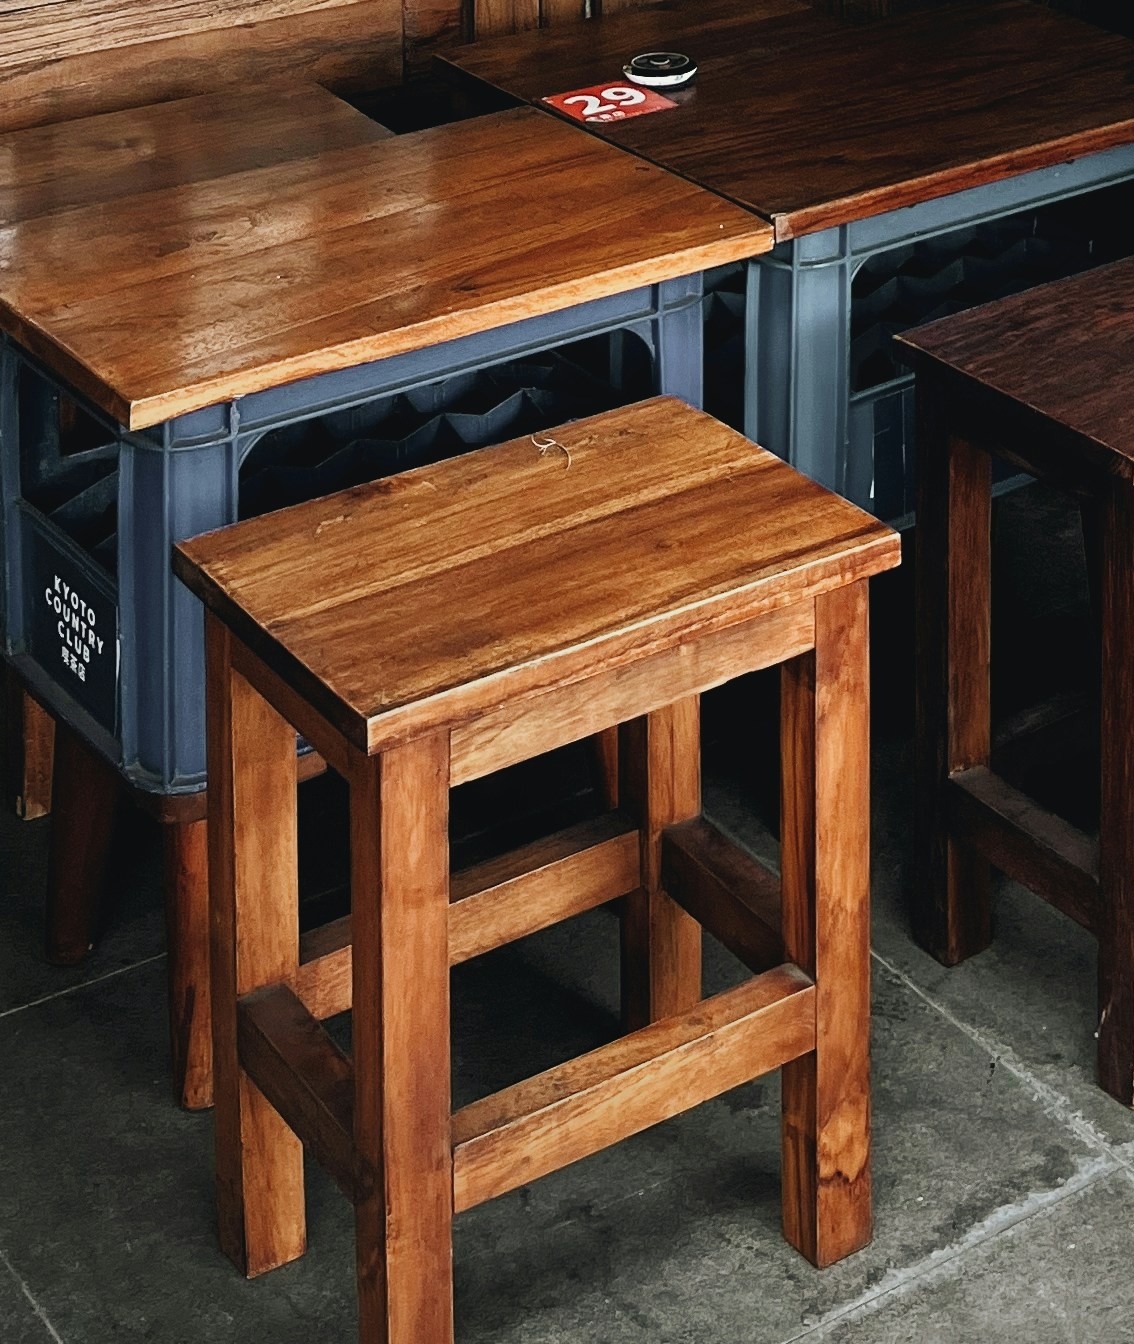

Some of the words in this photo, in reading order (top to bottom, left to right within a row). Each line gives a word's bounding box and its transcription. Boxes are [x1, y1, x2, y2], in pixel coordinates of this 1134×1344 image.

[563, 86, 647, 116] 29
[45, 587, 104, 655] COUNTRY
[54, 574, 96, 627] KYOTO
[57, 620, 90, 663] CLUB
